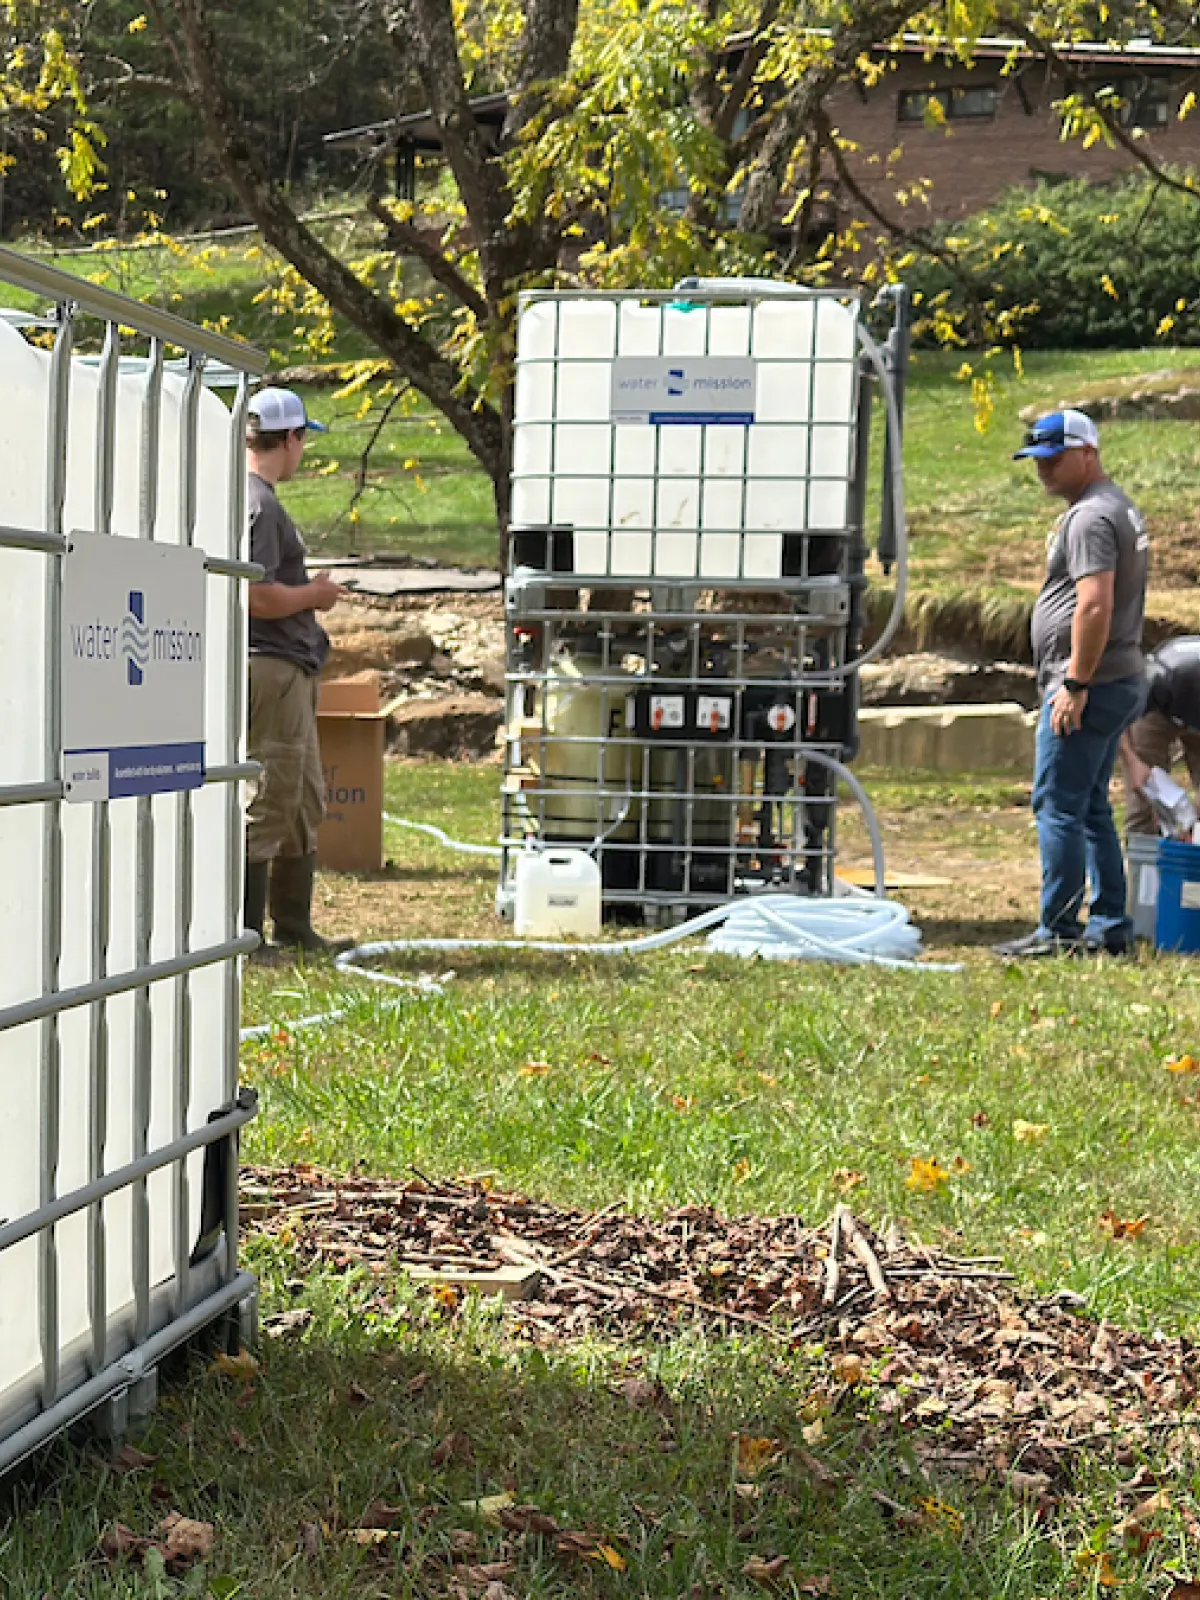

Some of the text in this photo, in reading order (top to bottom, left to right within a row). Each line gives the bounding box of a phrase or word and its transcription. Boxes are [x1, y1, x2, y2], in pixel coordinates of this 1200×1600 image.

[618, 376, 751, 390] water mission
[70, 617, 202, 662] water mission
